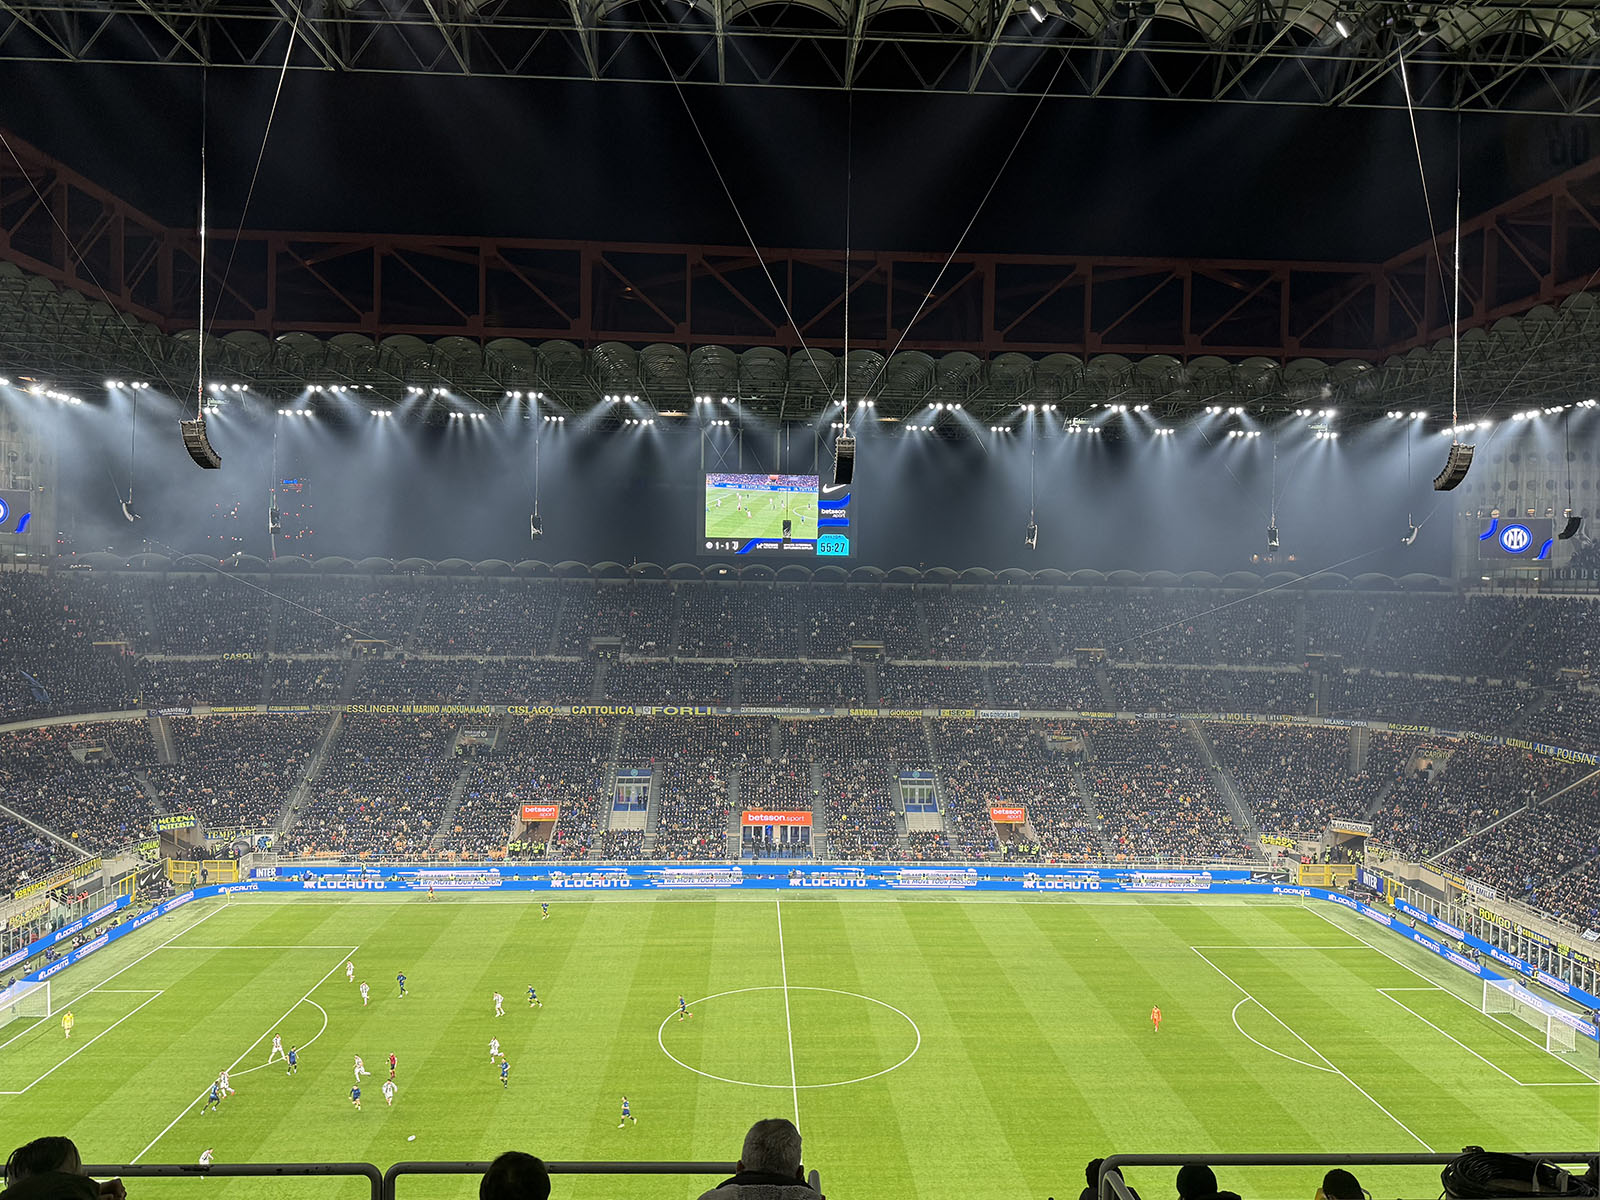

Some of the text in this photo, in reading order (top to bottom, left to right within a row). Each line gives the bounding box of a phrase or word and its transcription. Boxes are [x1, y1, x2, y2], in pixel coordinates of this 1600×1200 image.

[820, 542, 845, 553] 55:27
[347, 704, 399, 713] ESSLINGEN
[413, 704, 440, 714] MARINO
[507, 705, 554, 714] CISLAGO
[571, 705, 635, 715] CATTOLICA
[1227, 713, 1252, 721] MOLE
[1389, 722, 1429, 732] MOZZATE
[1557, 748, 1597, 766] POLESINE
[158, 815, 195, 825] MODENA
[256, 868, 276, 878] INTER
[1363, 873, 1378, 890] INTER
[1479, 908, 1511, 930] ROVIGO
